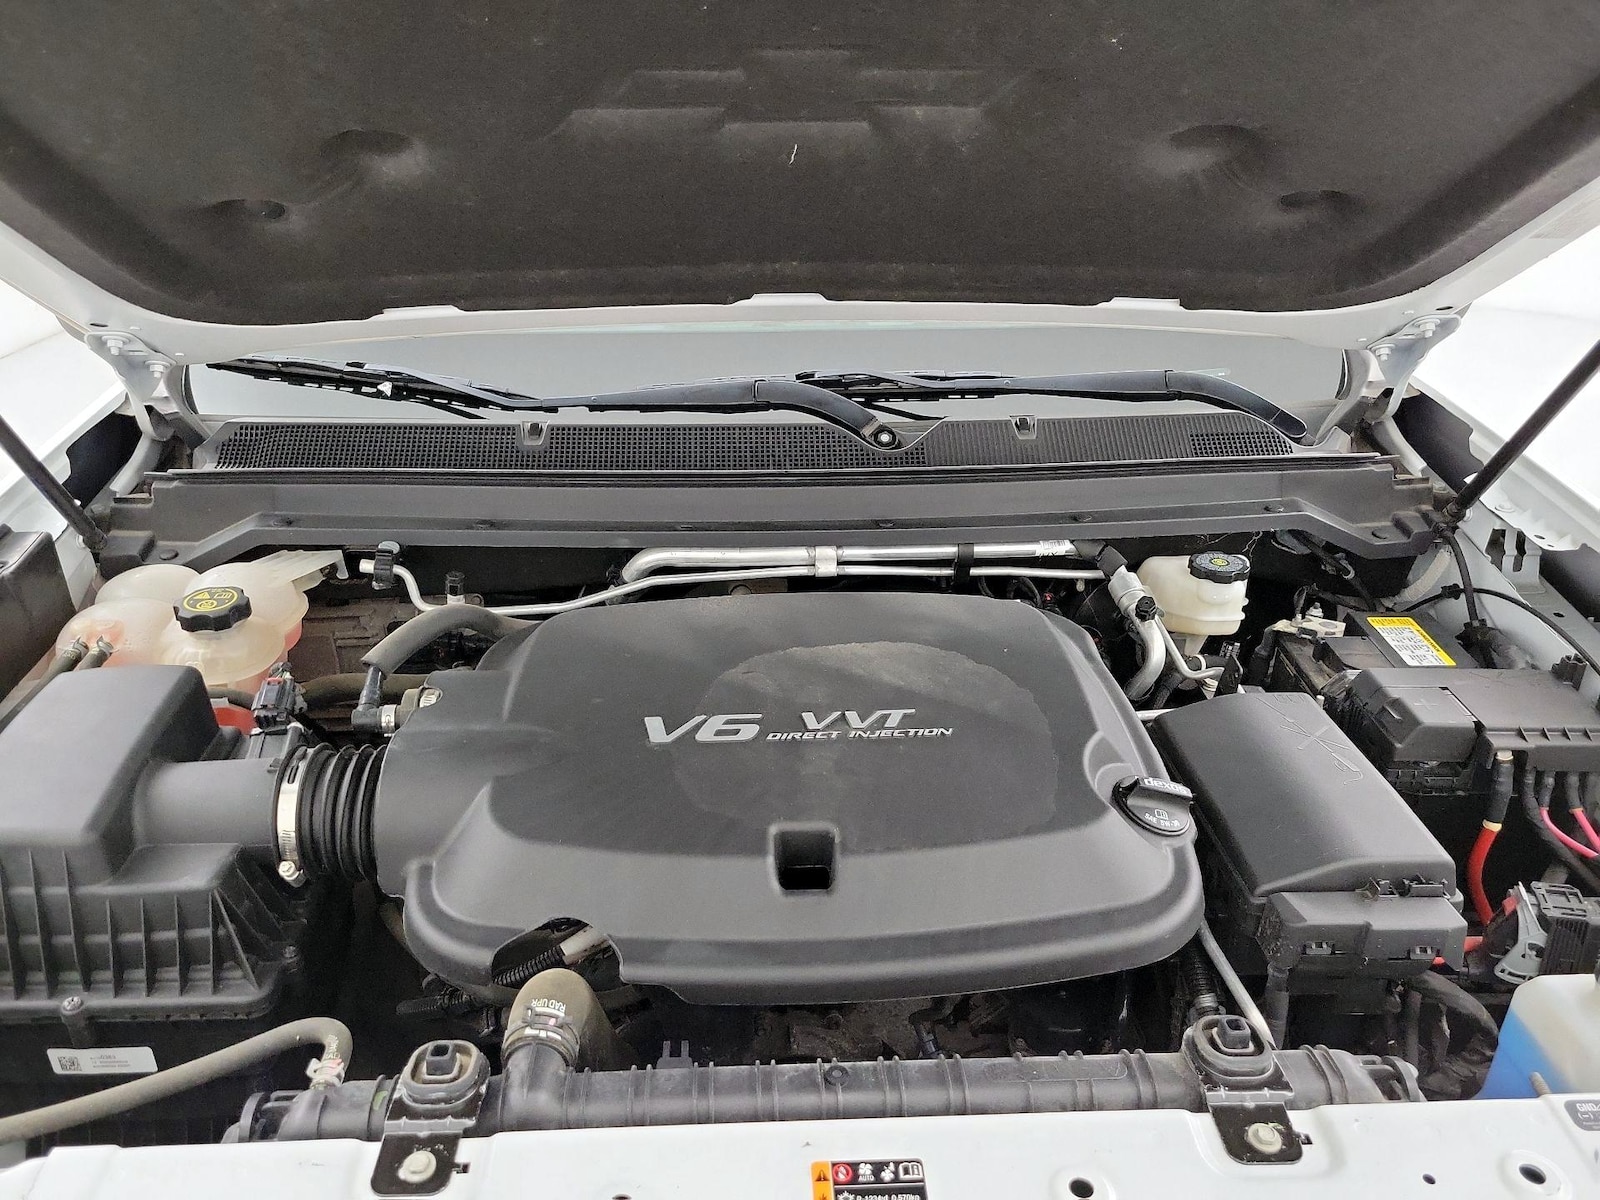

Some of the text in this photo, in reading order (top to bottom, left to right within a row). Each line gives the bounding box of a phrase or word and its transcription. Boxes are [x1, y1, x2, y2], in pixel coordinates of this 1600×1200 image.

[644, 709, 916, 743] V6 VVT
[766, 727, 953, 741] DIRECT INJECTION
[1144, 813, 1157, 824] SAE
[531, 998, 566, 1012] RAD UPR
[1576, 1103, 1597, 1111] GND
[858, 1174, 875, 1182] AUTO
